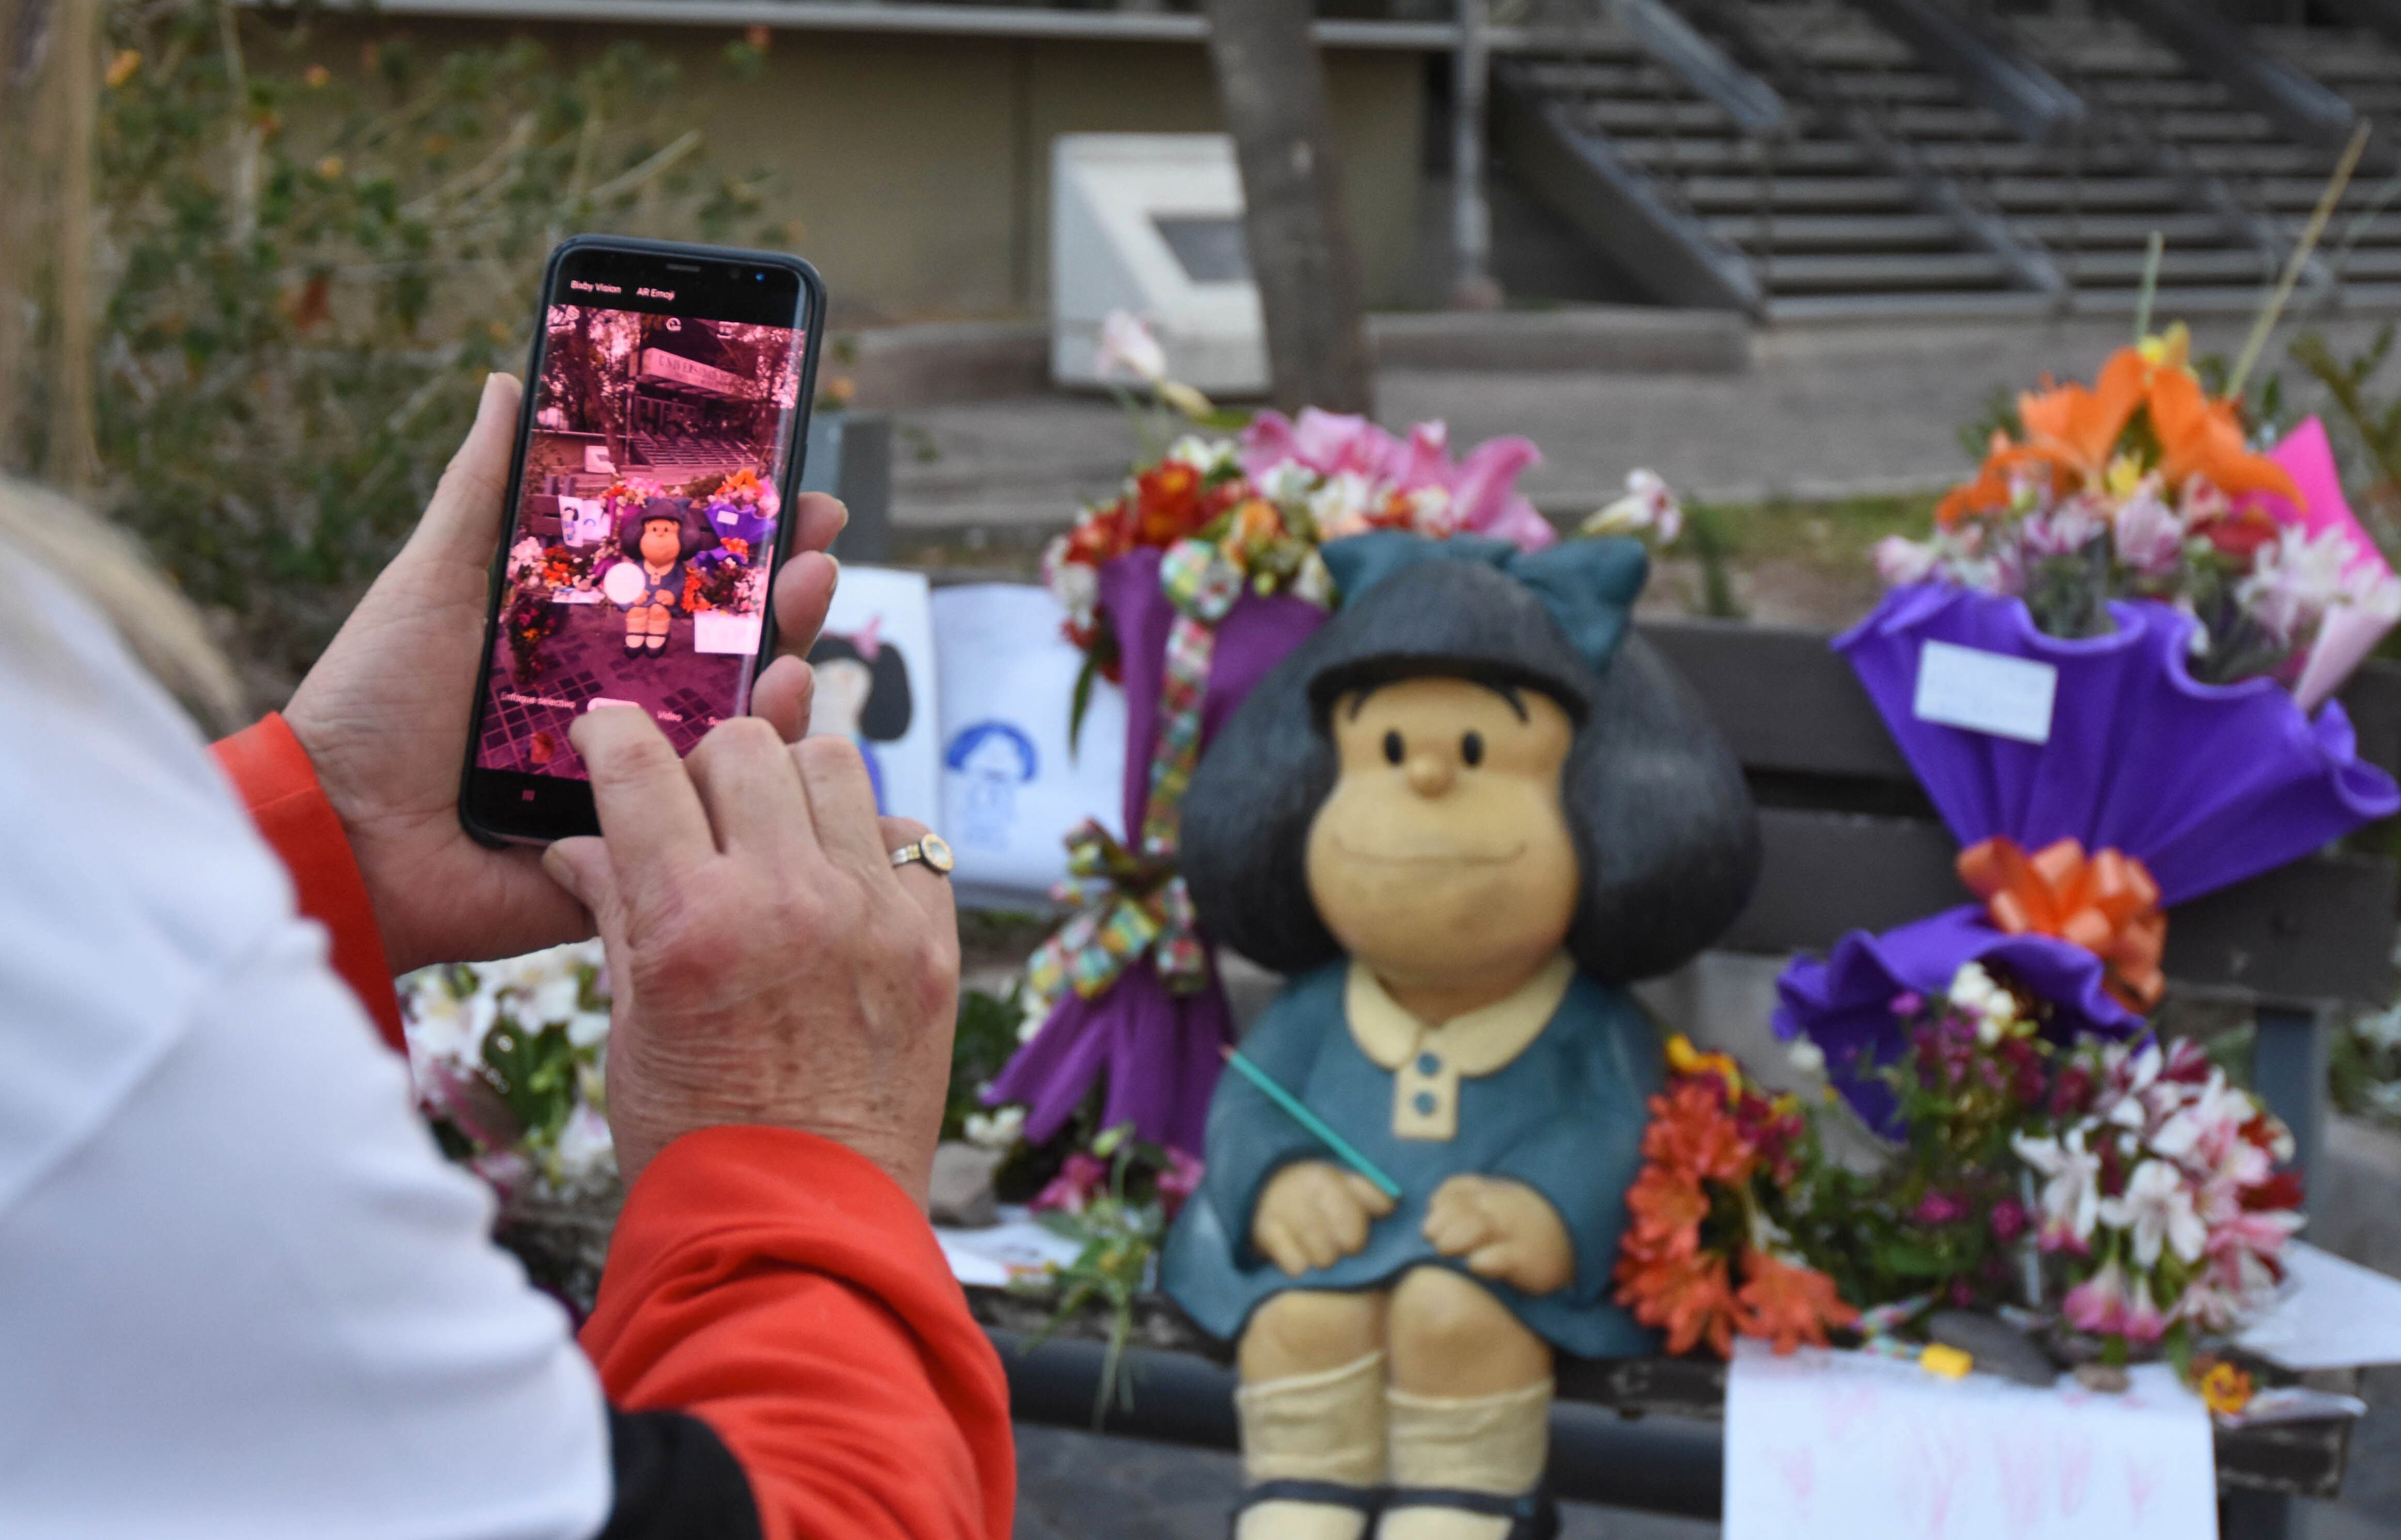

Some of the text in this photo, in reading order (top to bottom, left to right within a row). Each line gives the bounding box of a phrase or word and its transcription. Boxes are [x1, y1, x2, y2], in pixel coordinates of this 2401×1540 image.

[570, 279, 621, 293] Bixby Vision
[636, 287, 675, 301] AR Emoji
[537, 697, 576, 709] selectivo
